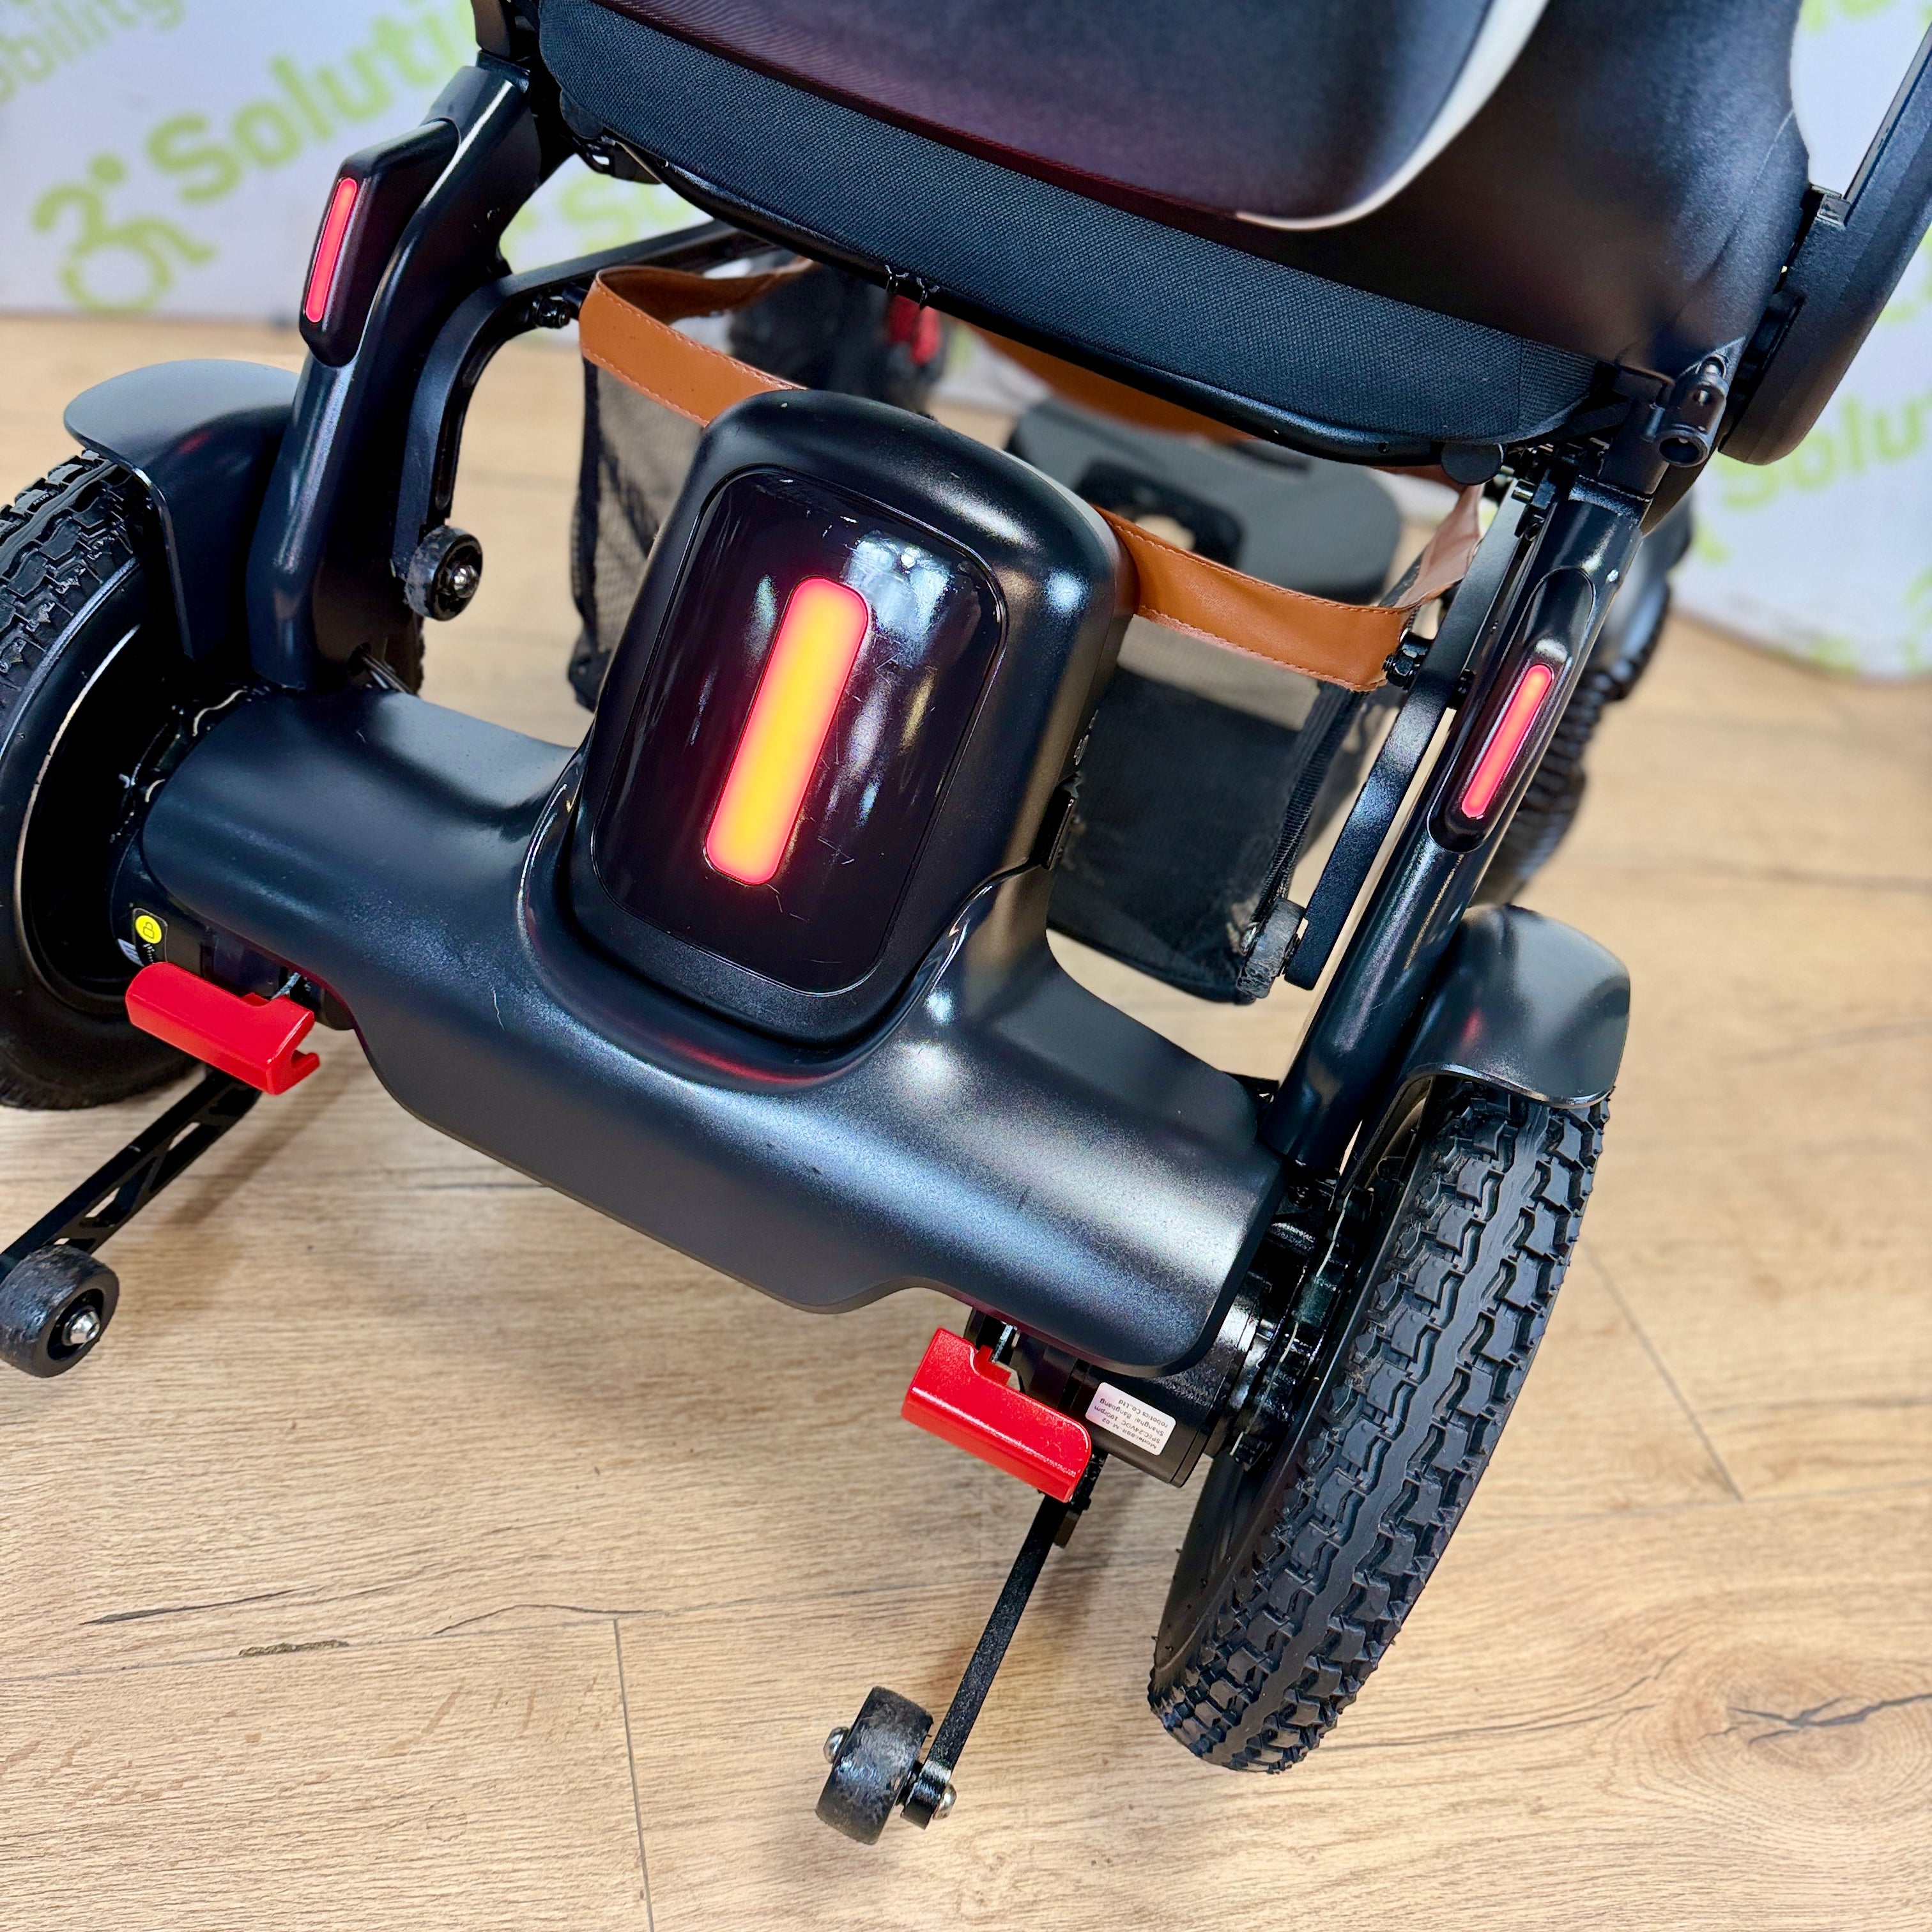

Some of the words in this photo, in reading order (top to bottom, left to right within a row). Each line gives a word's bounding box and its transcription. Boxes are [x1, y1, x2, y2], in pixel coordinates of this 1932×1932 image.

[1100, 1398, 1132, 1419] Bangbang
[1135, 1417, 1165, 1437] Shanghai
[1142, 1411, 1169, 1428] robotics
